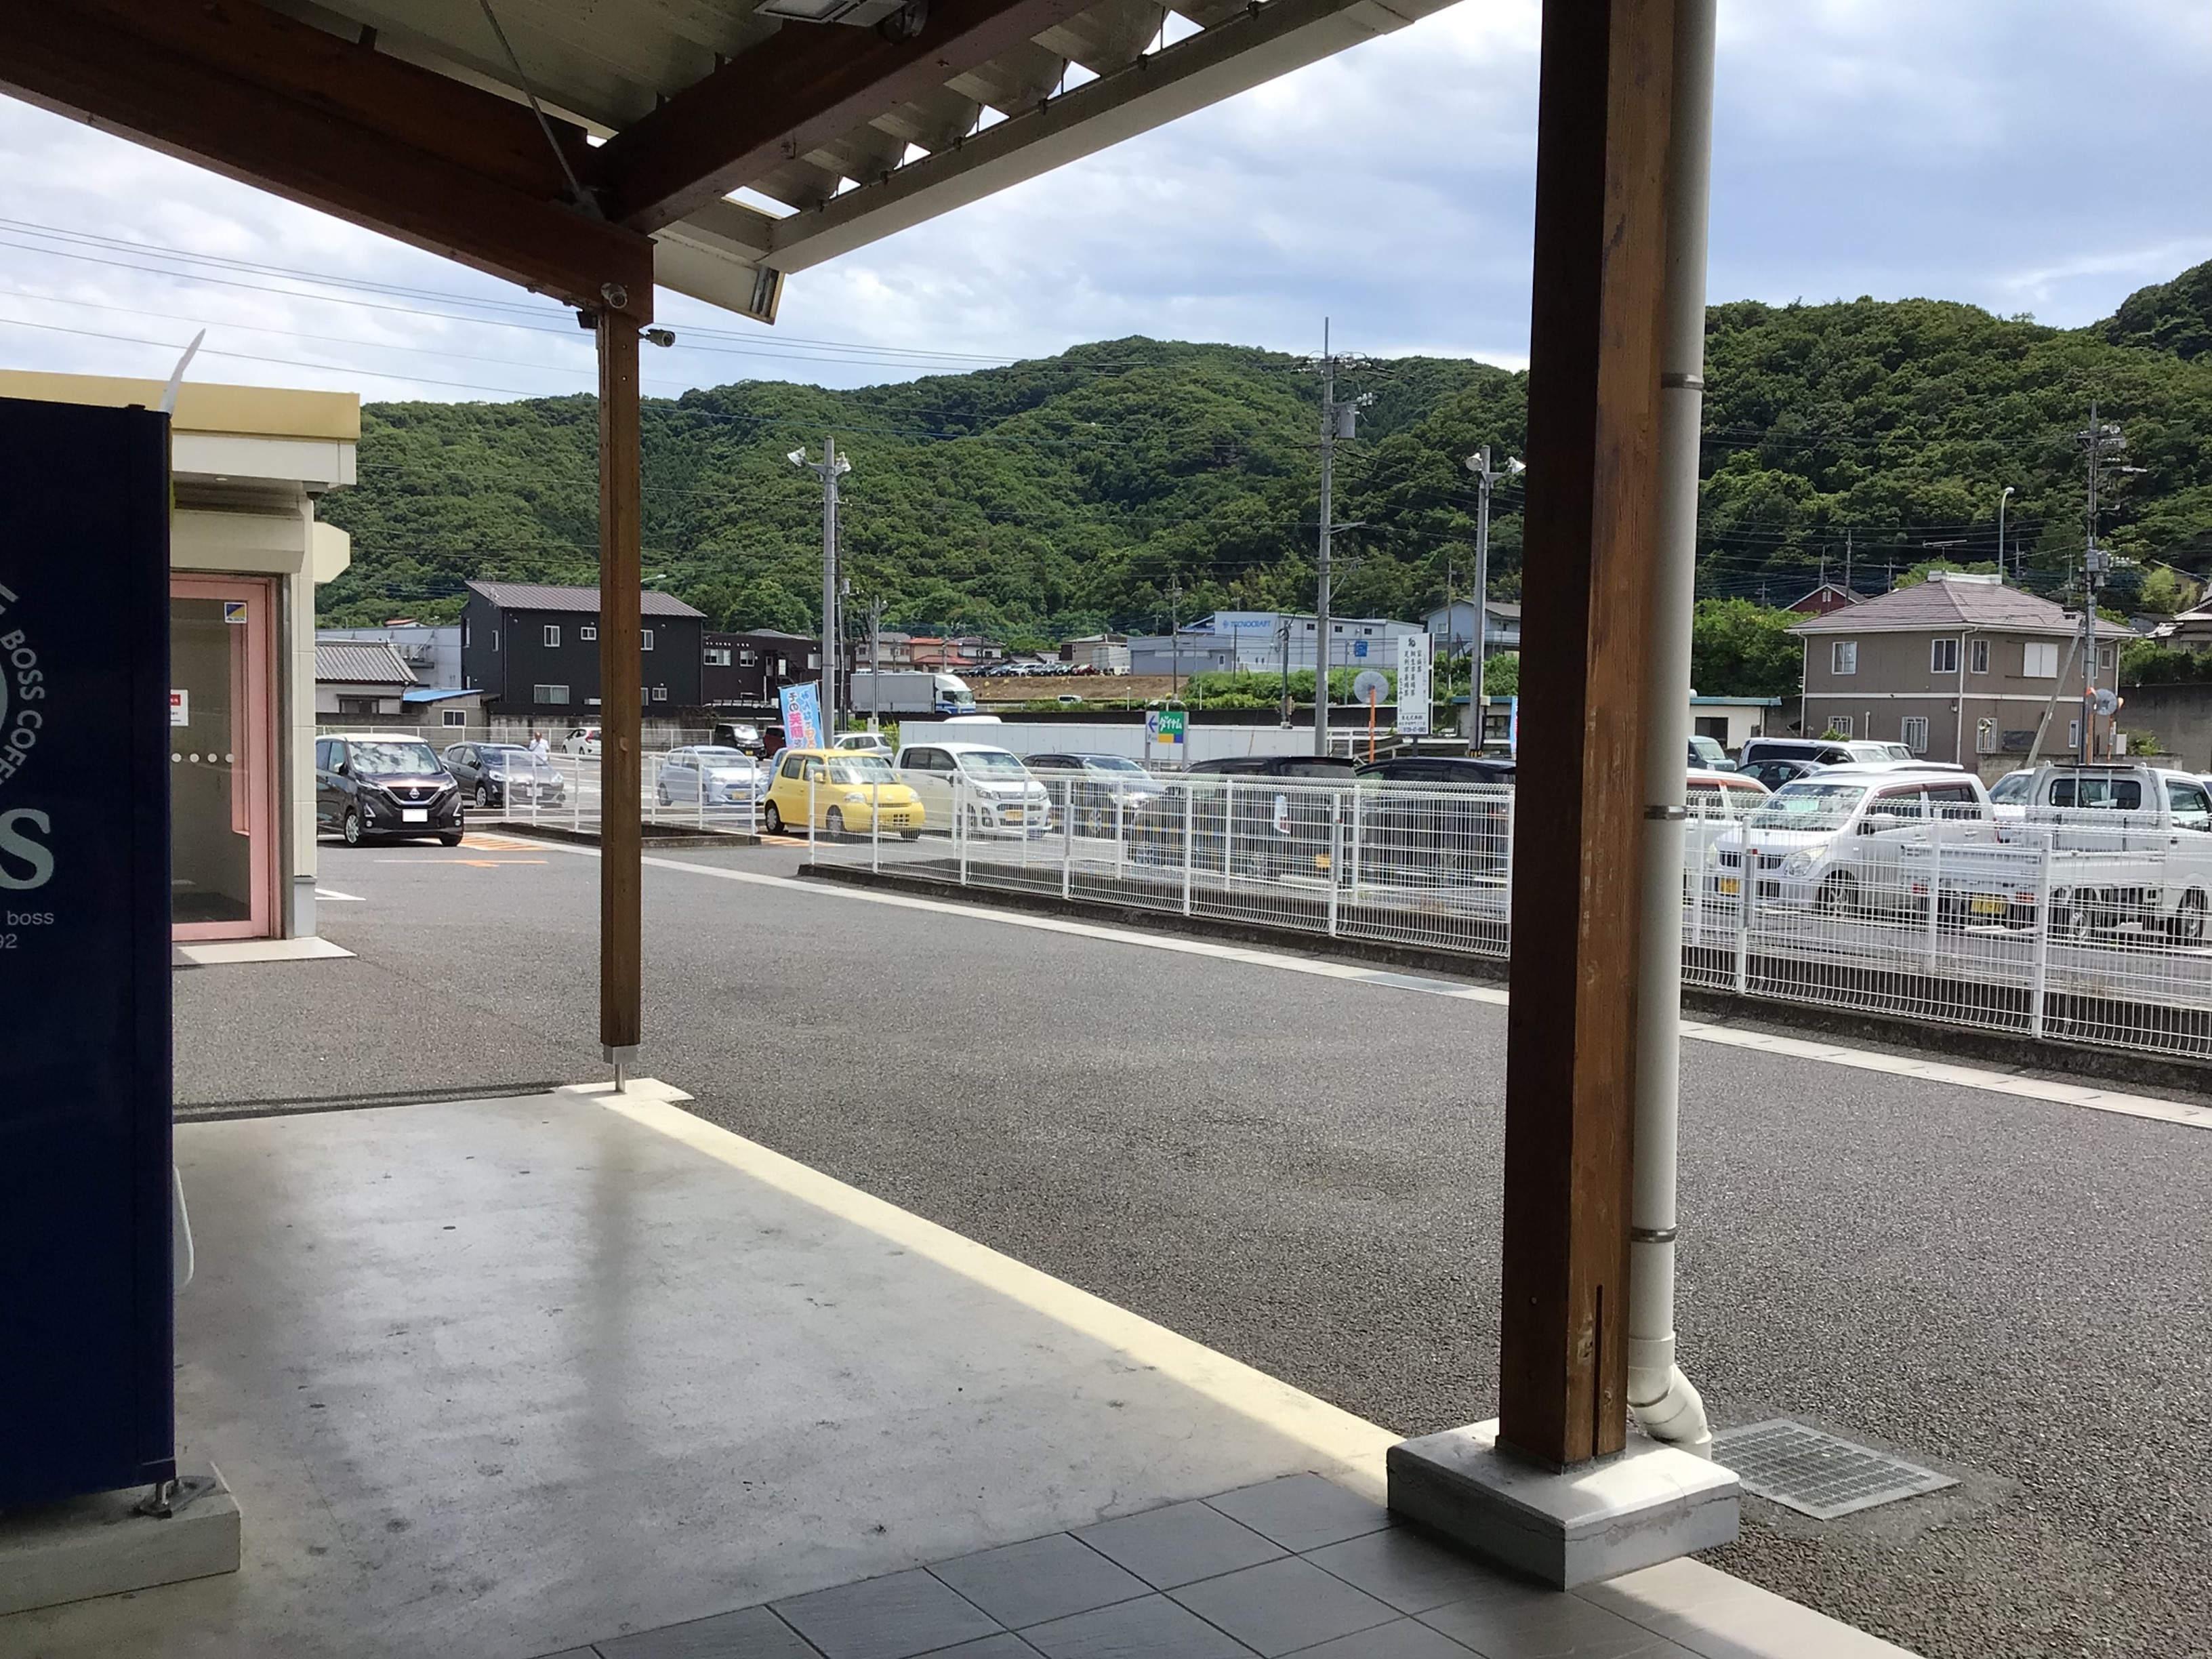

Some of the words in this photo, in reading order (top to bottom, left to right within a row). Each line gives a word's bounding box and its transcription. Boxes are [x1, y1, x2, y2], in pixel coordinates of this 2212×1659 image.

[0, 629, 45, 700] BOSS
[1160, 716, 1183, 732] ダイナム
[0, 710, 43, 785] COFF
[7, 910, 54, 925] boss
